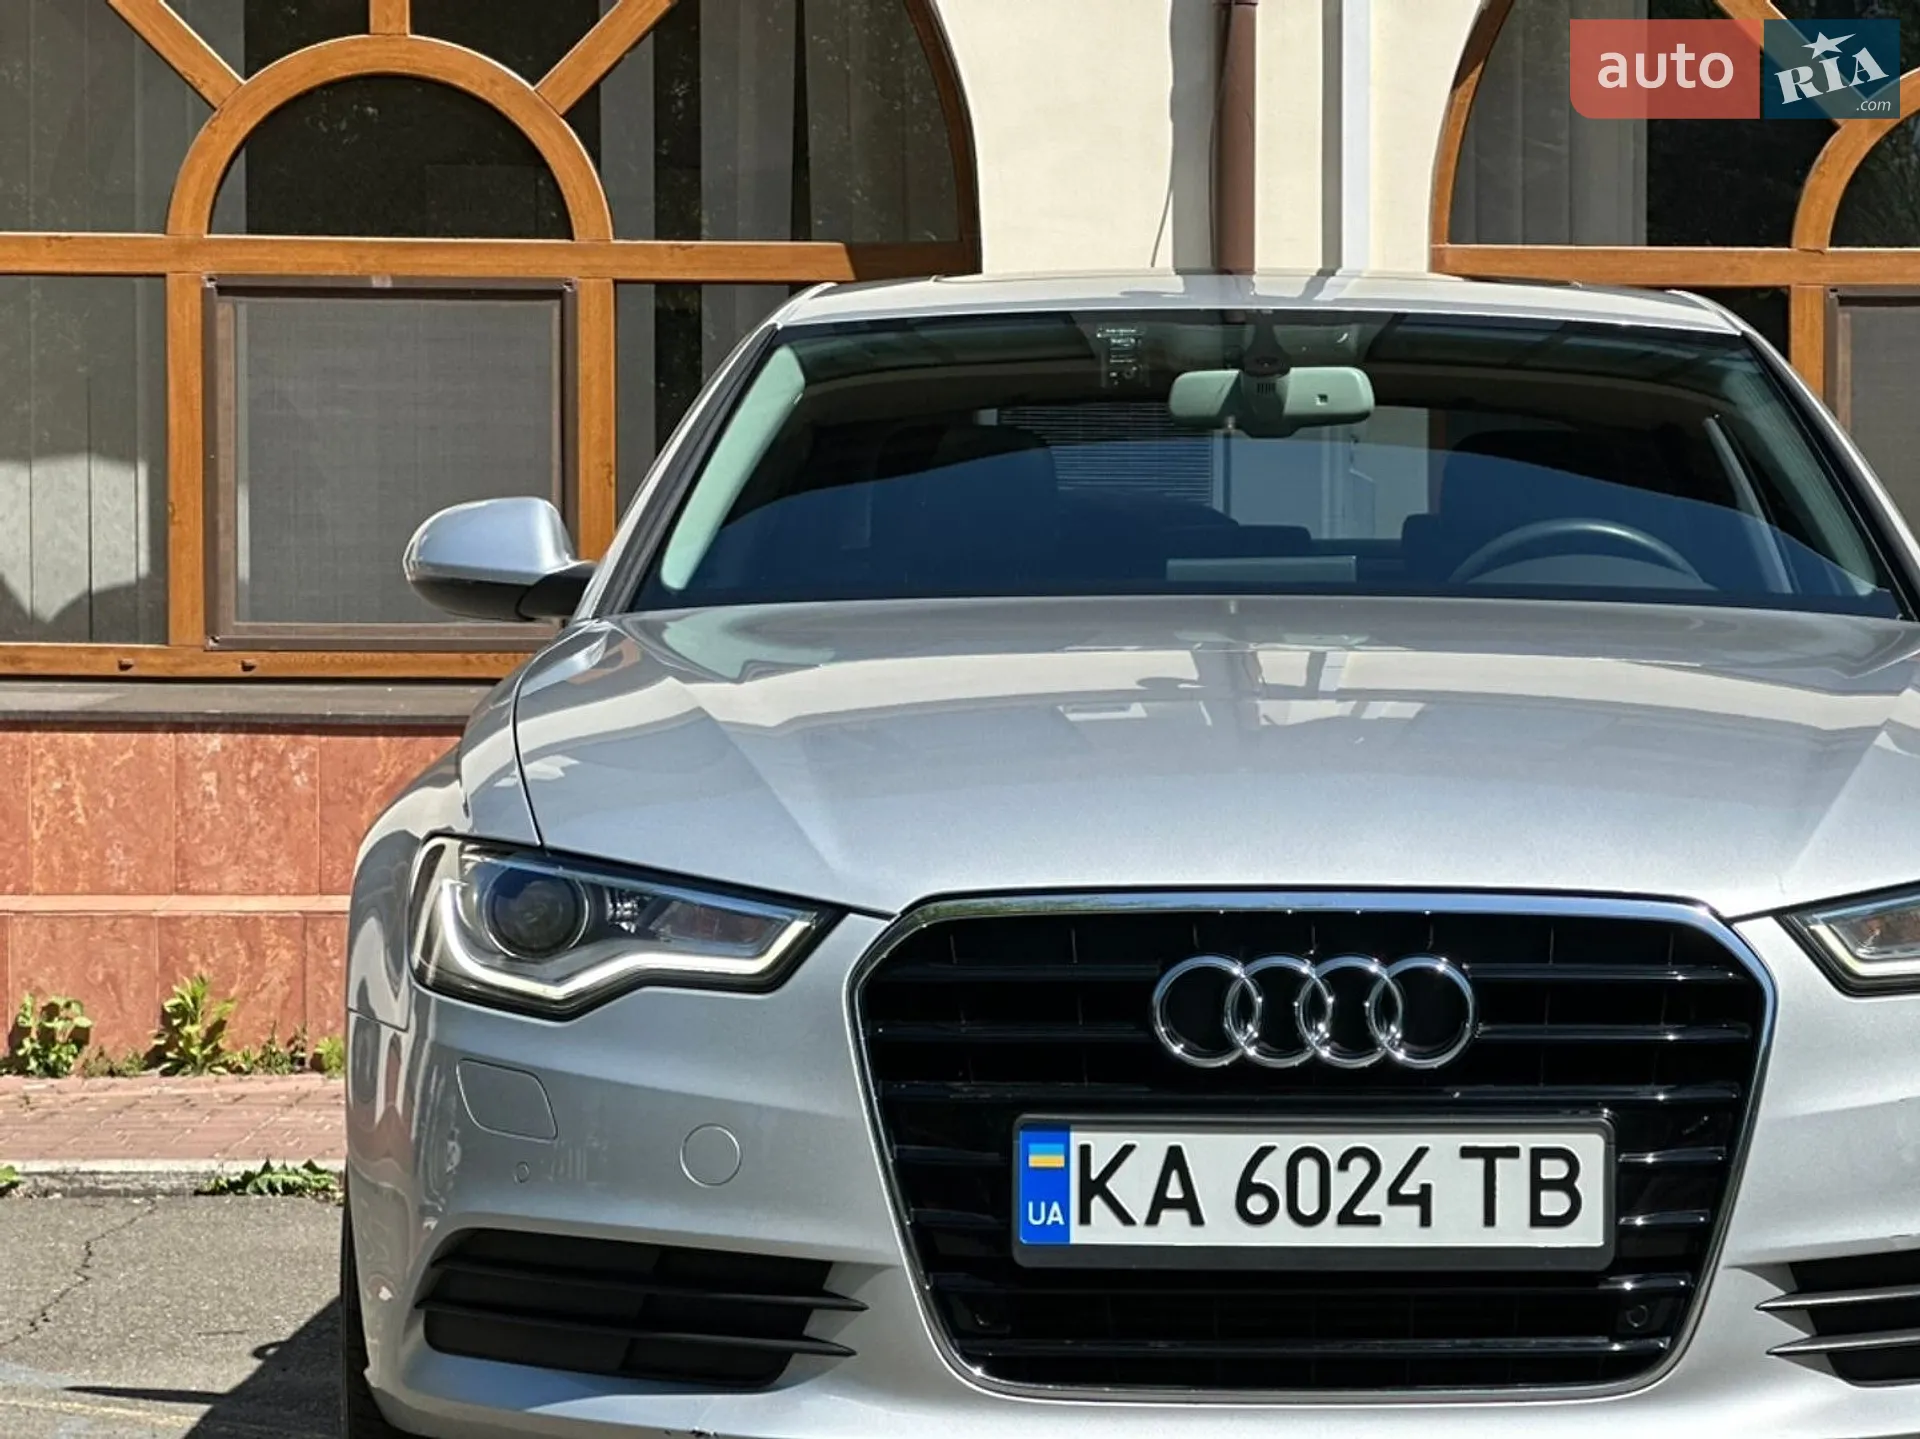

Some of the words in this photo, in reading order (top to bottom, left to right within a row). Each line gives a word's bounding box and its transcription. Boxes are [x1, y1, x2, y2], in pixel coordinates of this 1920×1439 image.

[1078, 1143, 1206, 1227] KA
[1235, 1145, 1432, 1227] 6024
[1460, 1146, 1582, 1227] TB
[1028, 1202, 1065, 1225] UA
